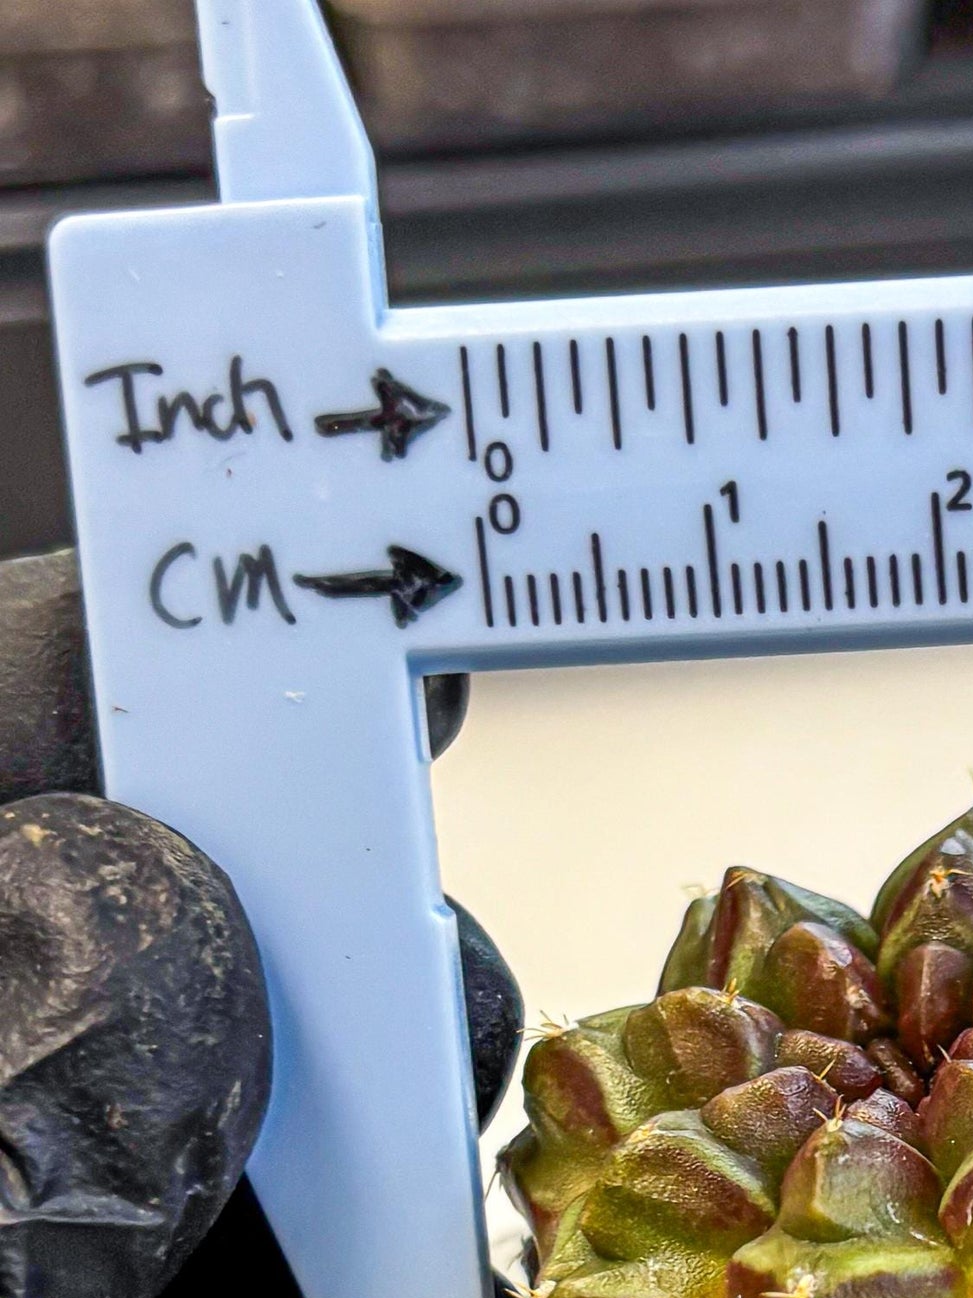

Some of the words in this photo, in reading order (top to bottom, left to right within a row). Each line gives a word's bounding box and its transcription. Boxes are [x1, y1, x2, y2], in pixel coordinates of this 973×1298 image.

[84, 355, 294, 454] Inch
[719, 480, 740, 523] 1
[945, 470, 973, 511] 2
